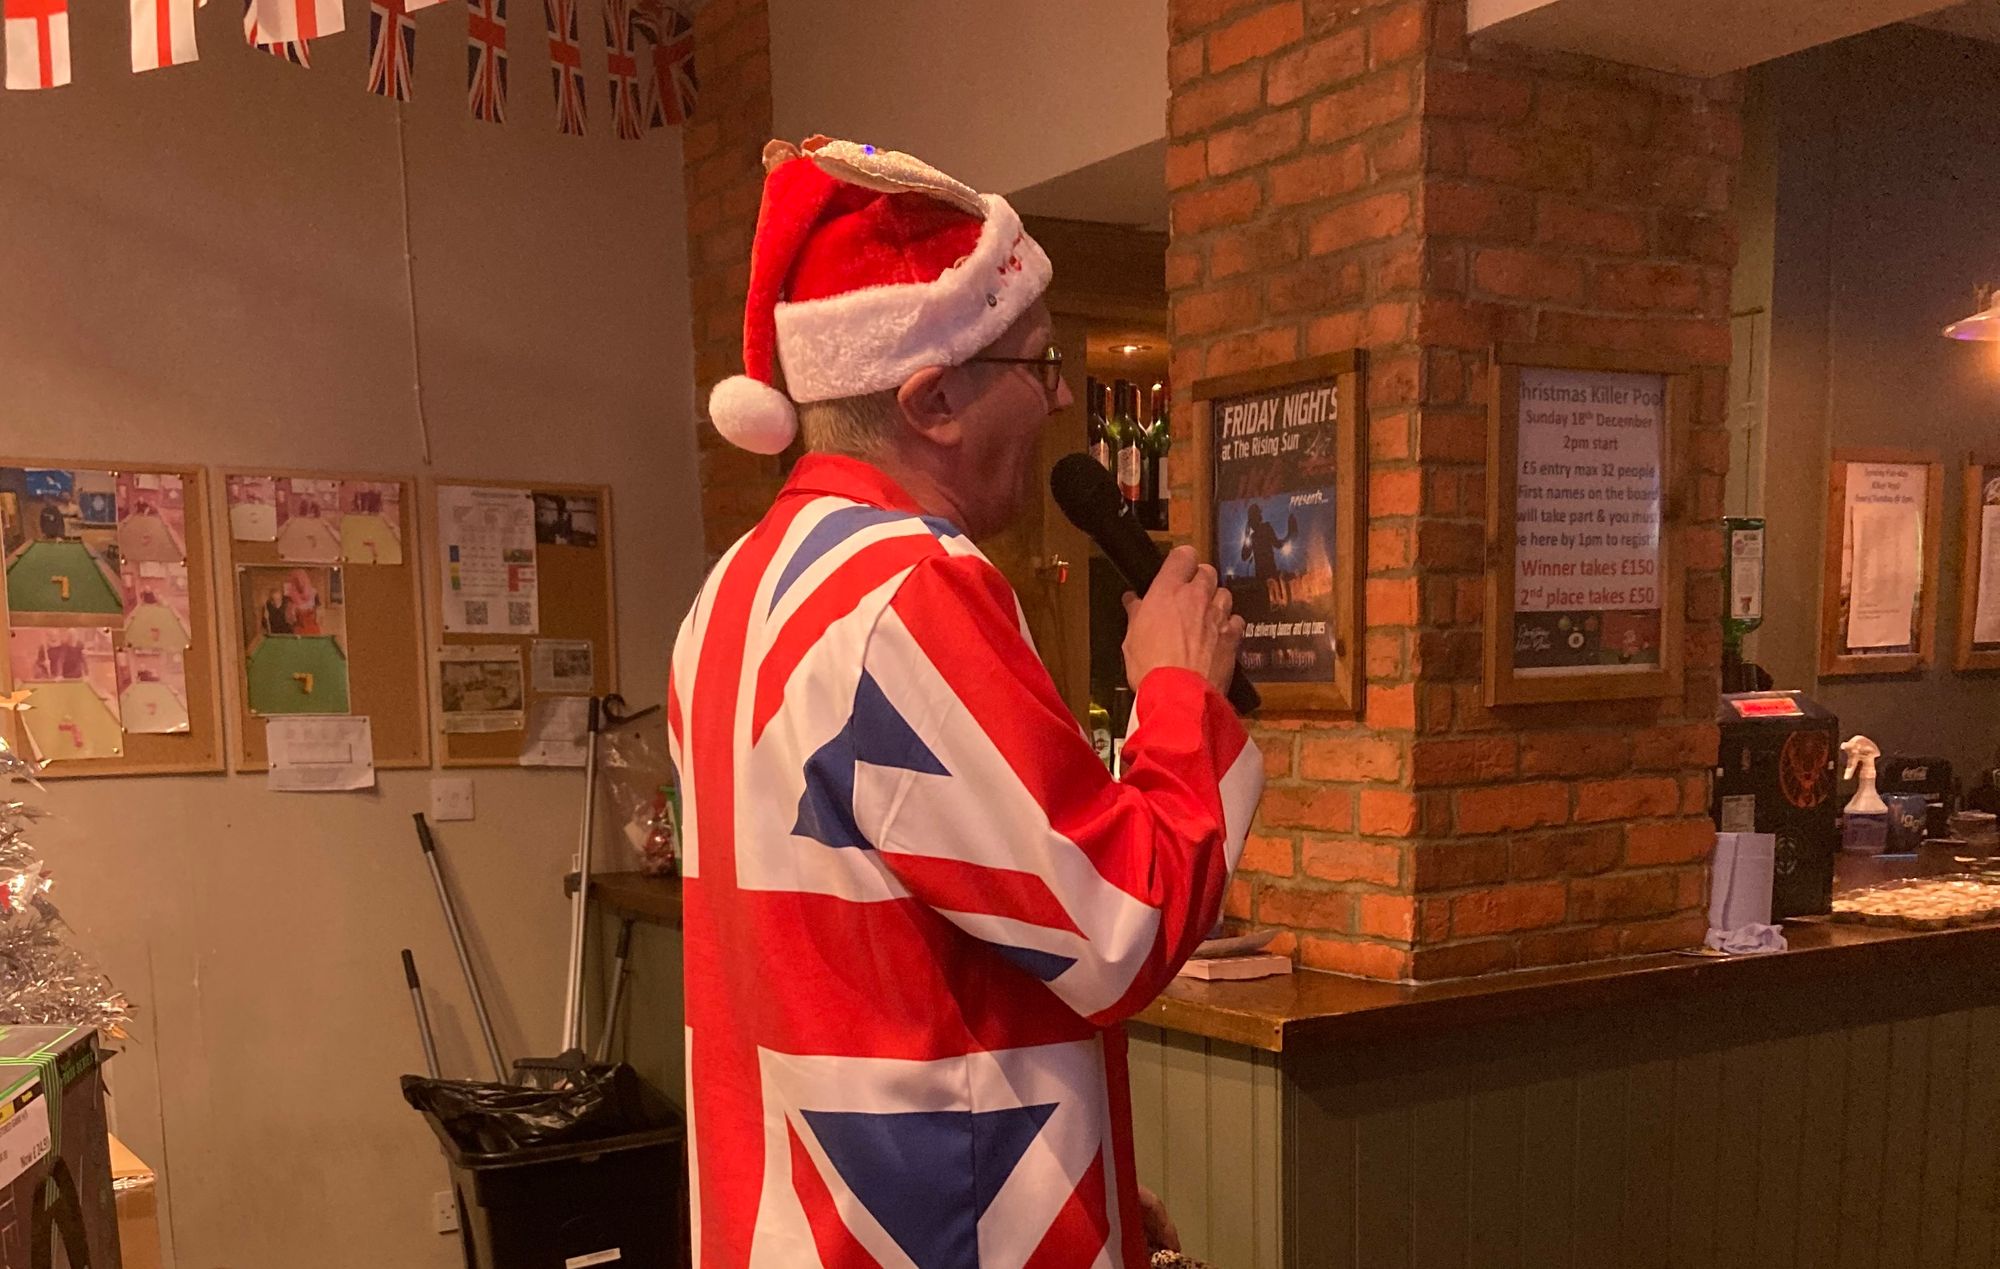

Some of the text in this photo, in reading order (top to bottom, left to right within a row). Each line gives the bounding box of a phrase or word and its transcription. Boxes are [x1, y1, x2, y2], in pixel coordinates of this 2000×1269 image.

[1520, 382, 1588, 403] hristmas
[1592, 385, 1630, 405] Killer
[1221, 386, 1339, 440] FRIDAY NIGHTS
[1525, 410, 1653, 429] Sunday 18th December
[1221, 444, 1232, 462] at
[1233, 440, 1250, 460] The
[1251, 436, 1280, 457] Rising
[1280, 431, 1301, 452] Sun
[1563, 435, 1618, 453] 2pm start
[1521, 460, 1656, 481] £5 entry max 32 people
[1518, 484, 1543, 500] First
[1545, 488, 1585, 501] names
[1587, 488, 1603, 501] on
[1604, 486, 1625, 501] the
[1517, 507, 1658, 527] will take part & you mus
[1530, 531, 1558, 546] here
[1560, 531, 1575, 550] by
[1578, 532, 1603, 550] 1pm
[1606, 533, 1618, 547] to
[1521, 558, 1654, 577] Winner takes £150
[1519, 586, 1655, 608] 2nd place takes £50
